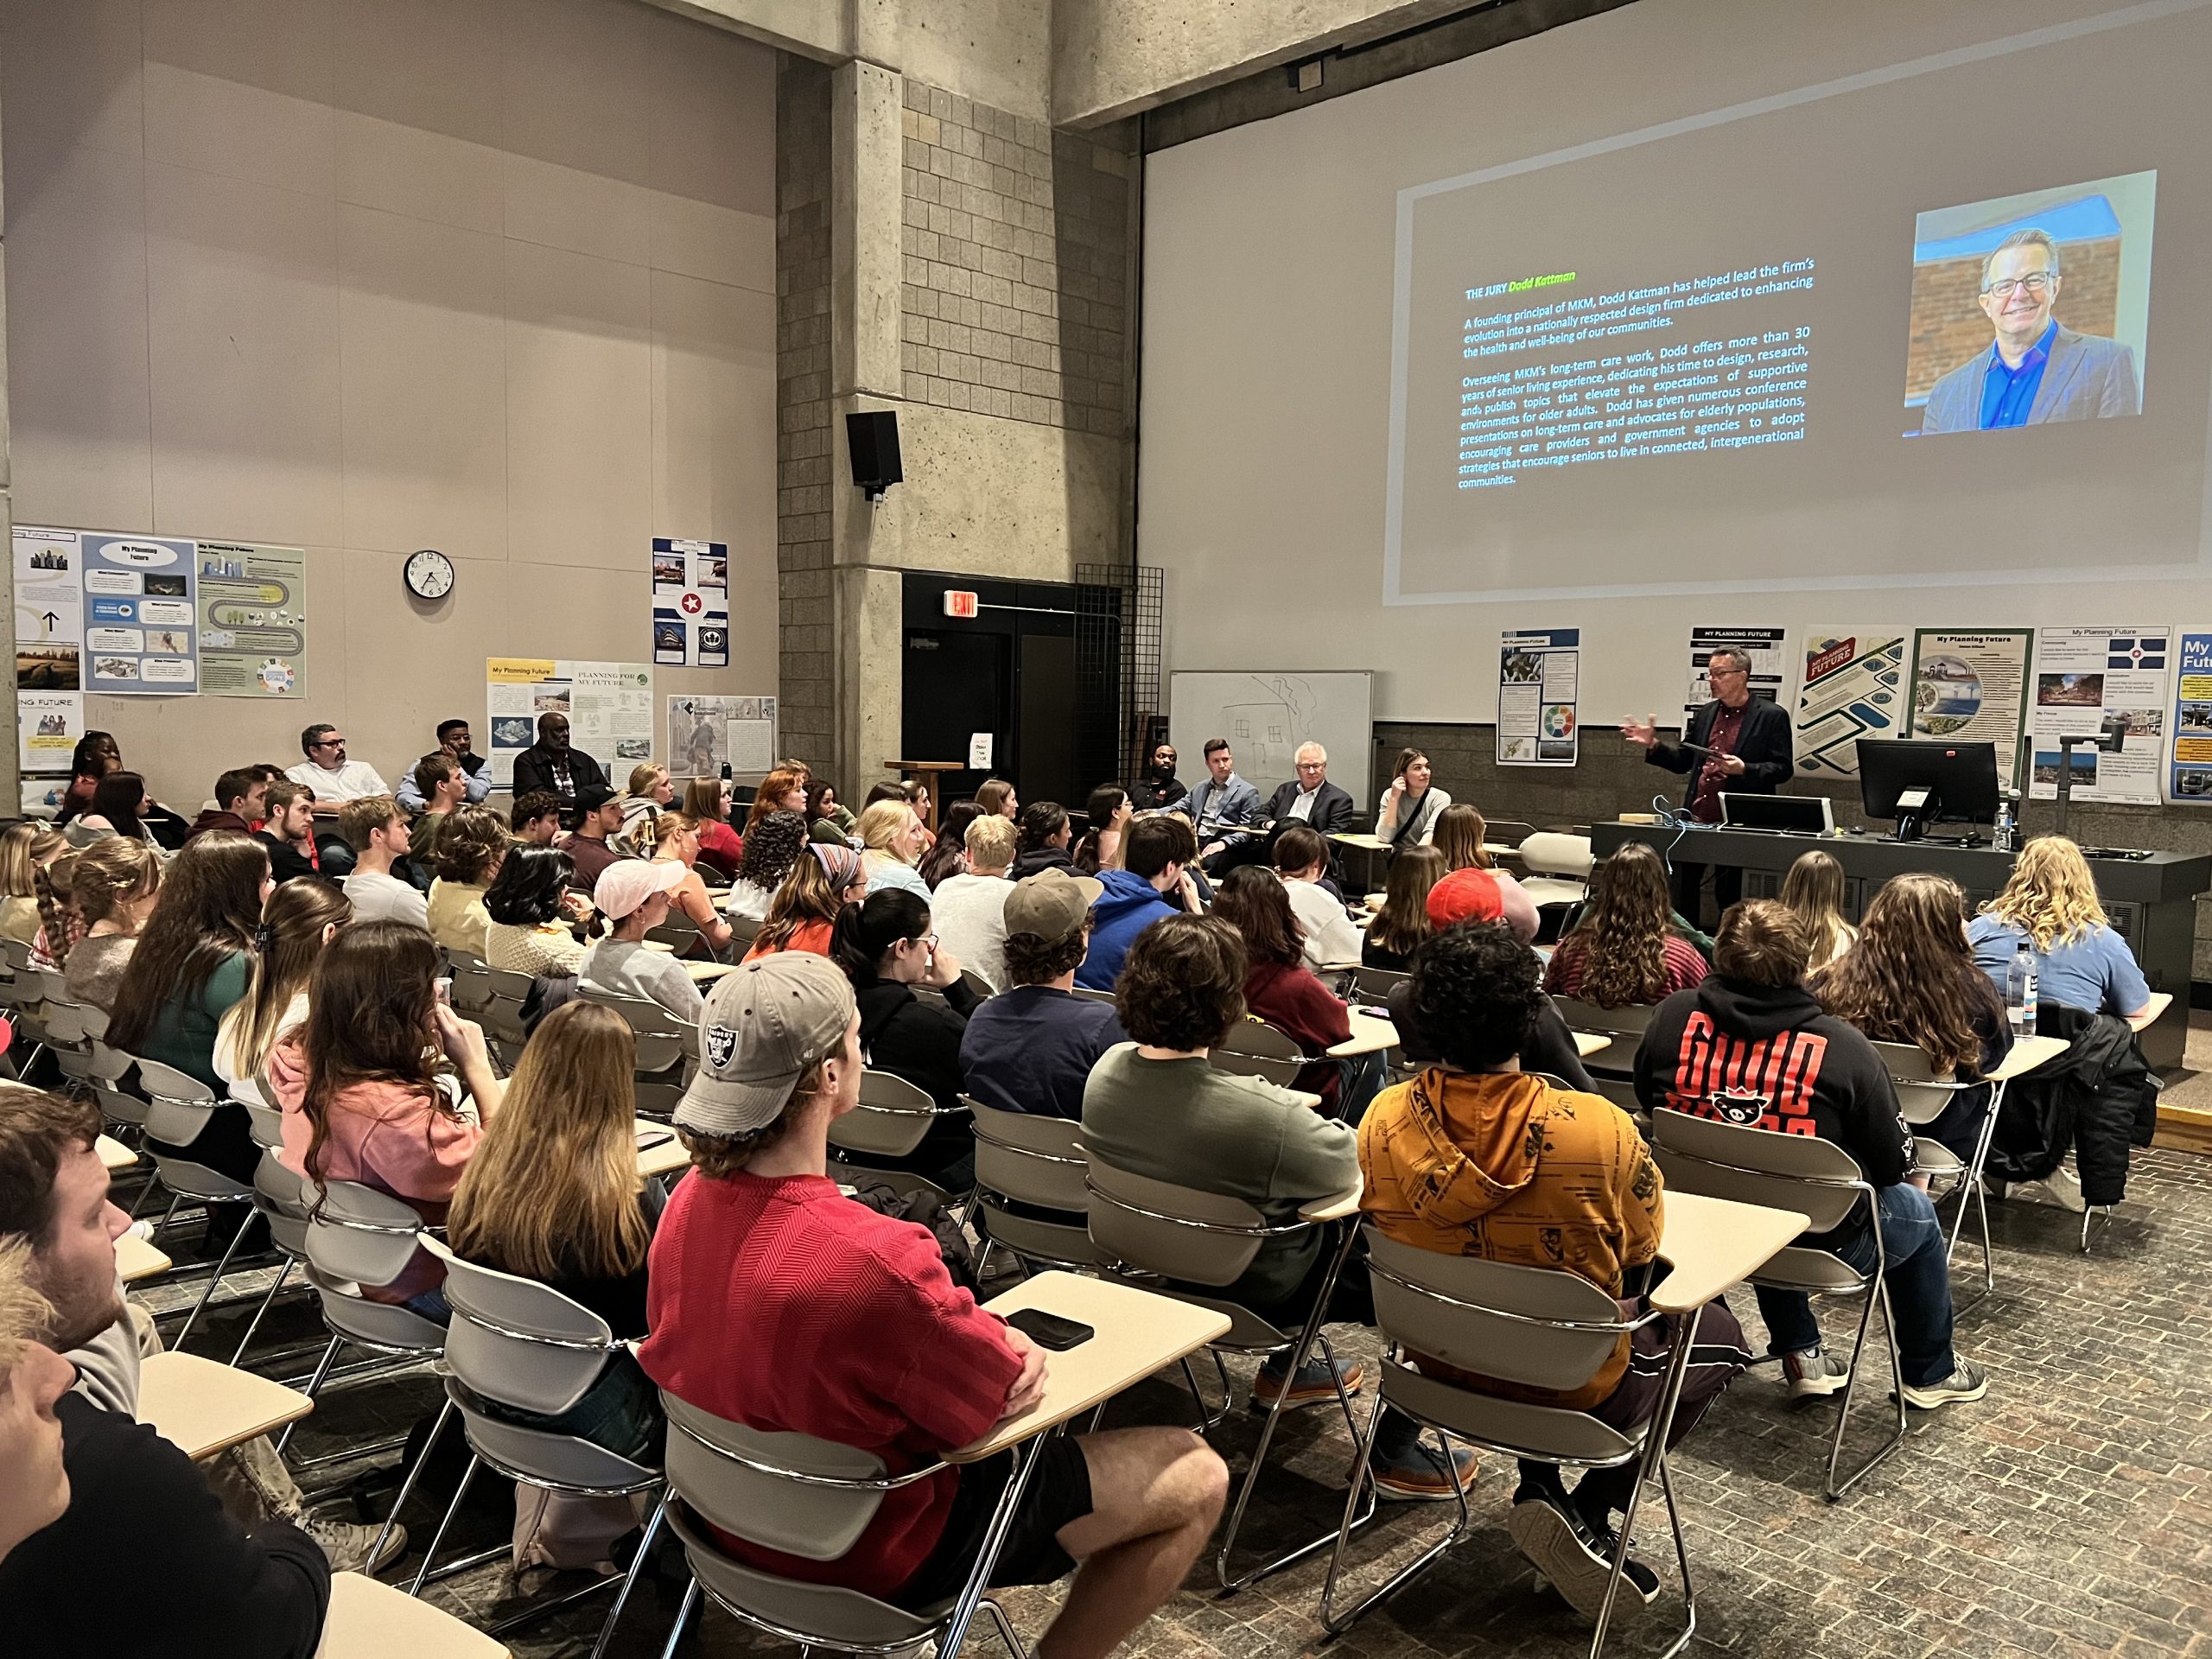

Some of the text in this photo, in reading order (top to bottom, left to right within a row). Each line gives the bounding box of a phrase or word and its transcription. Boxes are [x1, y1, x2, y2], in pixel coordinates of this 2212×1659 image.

[1464, 318, 1471, 329] A
[1473, 313, 1512, 327] founding
[1514, 303, 1553, 322] principal
[1554, 302, 1566, 313] of
[1567, 296, 1597, 311] MKM,
[1599, 291, 1624, 305] Dodd
[1628, 285, 1669, 301] Kattman
[1673, 282, 1690, 293] has
[1694, 272, 1730, 289] helped
[1732, 268, 1756, 282] lead
[1759, 266, 1778, 277] the
[1464, 328, 1504, 343] evolution
[1506, 326, 1524, 336] into
[1533, 315, 1579, 332] nationally
[1580, 306, 1626, 324] respected
[1628, 302, 1661, 315] design
[1662, 299, 1684, 310] firm
[1687, 288, 1738, 306] dedicated
[1740, 287, 1752, 297] to
[1754, 276, 1813, 295] enhancing
[1465, 271, 1576, 300] THE JURY Dodd Kattman
[1462, 327, 1810, 387] Overseeing MKM's long-term care work, Dodd offers more than 30
[1463, 316, 1674, 358] the health and well-being of our communities.
[1461, 343, 1808, 404] years of senior living experience, dedicating his time to design, research,
[1484, 399, 1516, 415] publish
[1522, 396, 1550, 409] topics
[1557, 392, 1578, 404] that
[1585, 387, 1620, 399] elevate
[1628, 383, 1645, 394] the
[1653, 374, 1718, 391] expectations
[1726, 370, 1738, 381] of
[1747, 362, 1808, 379] supportive
[1460, 379, 1807, 430] environments for older adults. Dodd has given numerous conference
[1460, 396, 1806, 447] presentations on long-term care and advocates for elderly populations,
[1459, 412, 1804, 460] encouraging care providers and government agencies to adopt
[1459, 429, 1803, 474] strategies that encourage seniors to live in connected, intergenerational
[1458, 474, 1516, 488] communities.
[952, 592, 975, 615] EXIT
[1811, 648, 1851, 676] FUTURE
[2184, 640, 2210, 655] My
